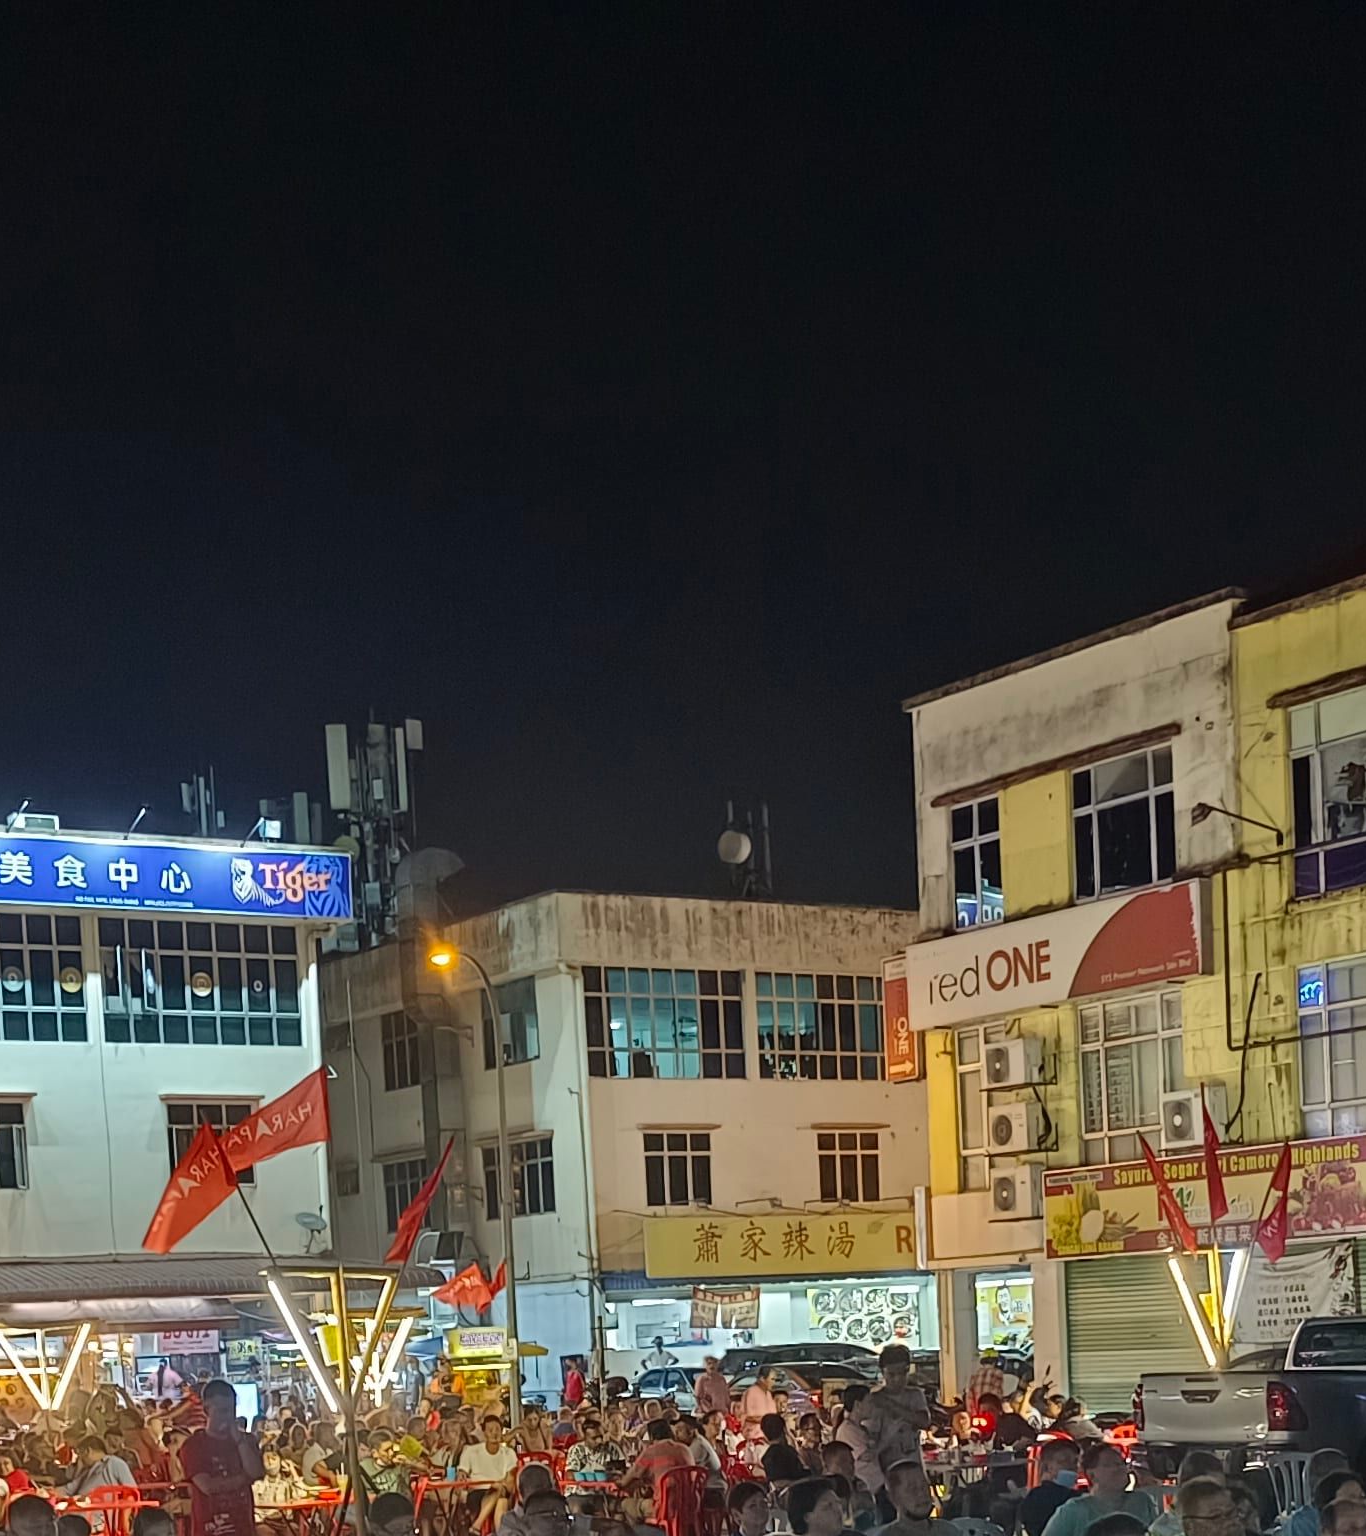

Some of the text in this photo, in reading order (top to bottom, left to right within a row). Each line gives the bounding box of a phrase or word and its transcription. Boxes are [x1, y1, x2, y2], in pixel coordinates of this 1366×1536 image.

[258, 861, 333, 903] Tiger
[1163, 1158, 1200, 1180] Segar
[1230, 1146, 1280, 1173] Camero
